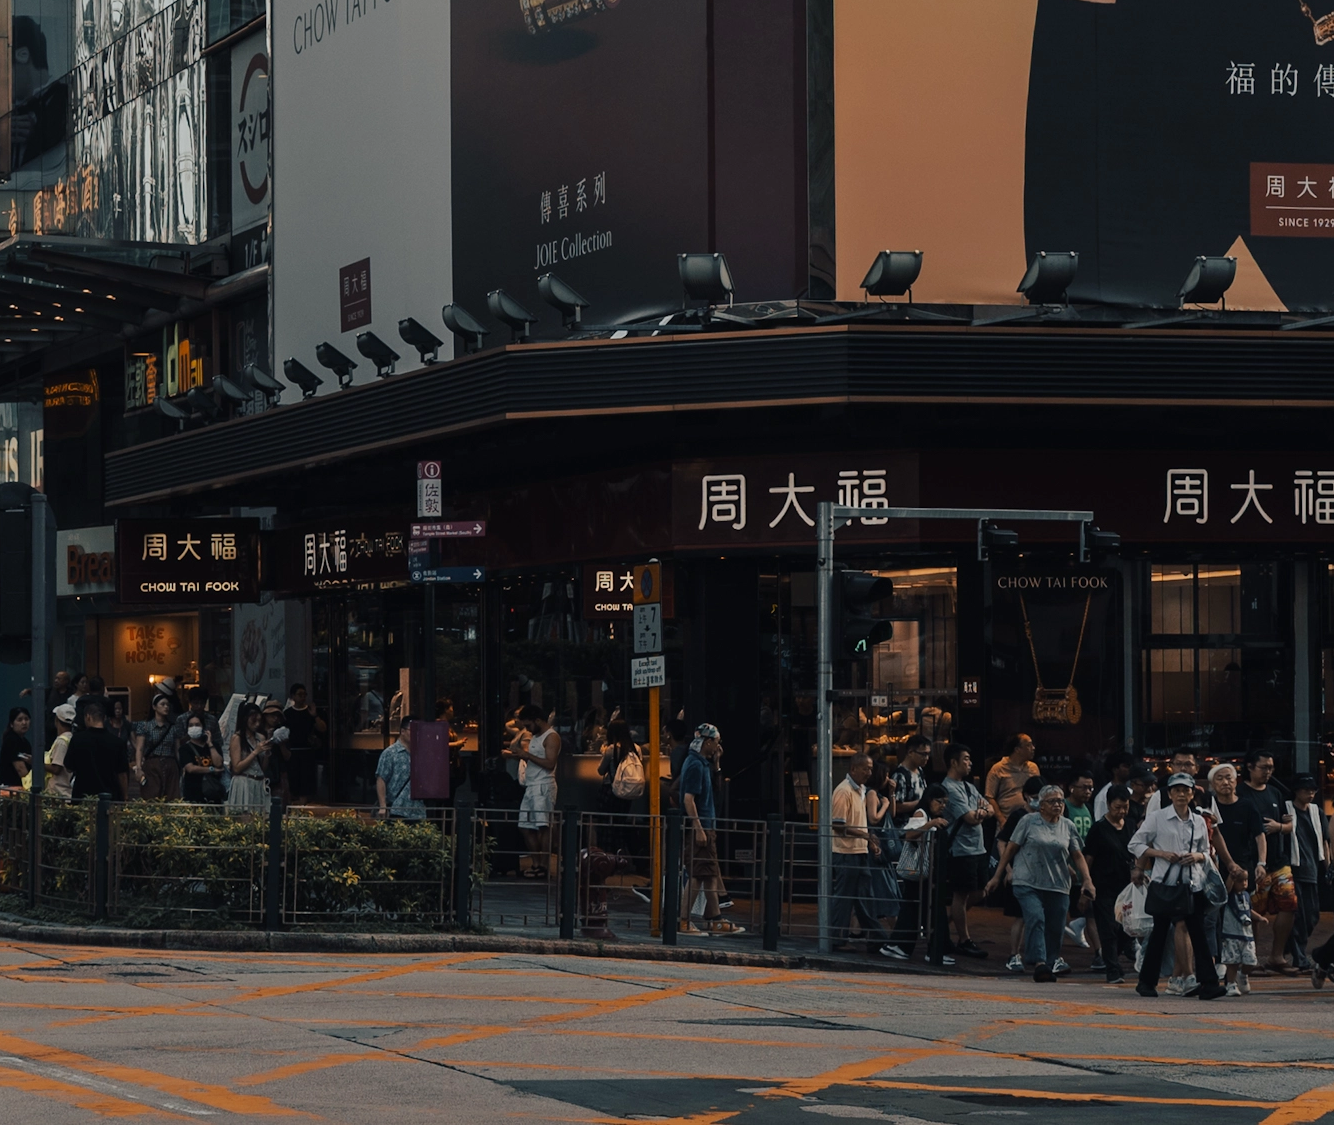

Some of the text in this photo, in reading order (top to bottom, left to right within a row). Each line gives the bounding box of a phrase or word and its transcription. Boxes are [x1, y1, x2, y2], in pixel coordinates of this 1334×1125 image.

[539, 171, 607, 226] 傳喜系列
[1278, 217, 1310, 228] SINCE
[534, 227, 613, 271] JOIE Collection
[425, 483, 440, 513] 佐敦
[698, 469, 890, 531] 周大福
[141, 533, 237, 561] 周大福
[304, 529, 348, 576] 周大福
[67, 544, 115, 585] Brea
[140, 581, 240, 593] CHOW TAI FOOK
[997, 577, 1108, 589] CHOW TAI FOOK
[595, 604, 620, 612] CHOW
[651, 607, 656, 623] 7
[126, 625, 165, 641] TAKE
[651, 633, 656, 649] 7
[136, 638, 155, 651] ME
[126, 650, 165, 665] HOME
